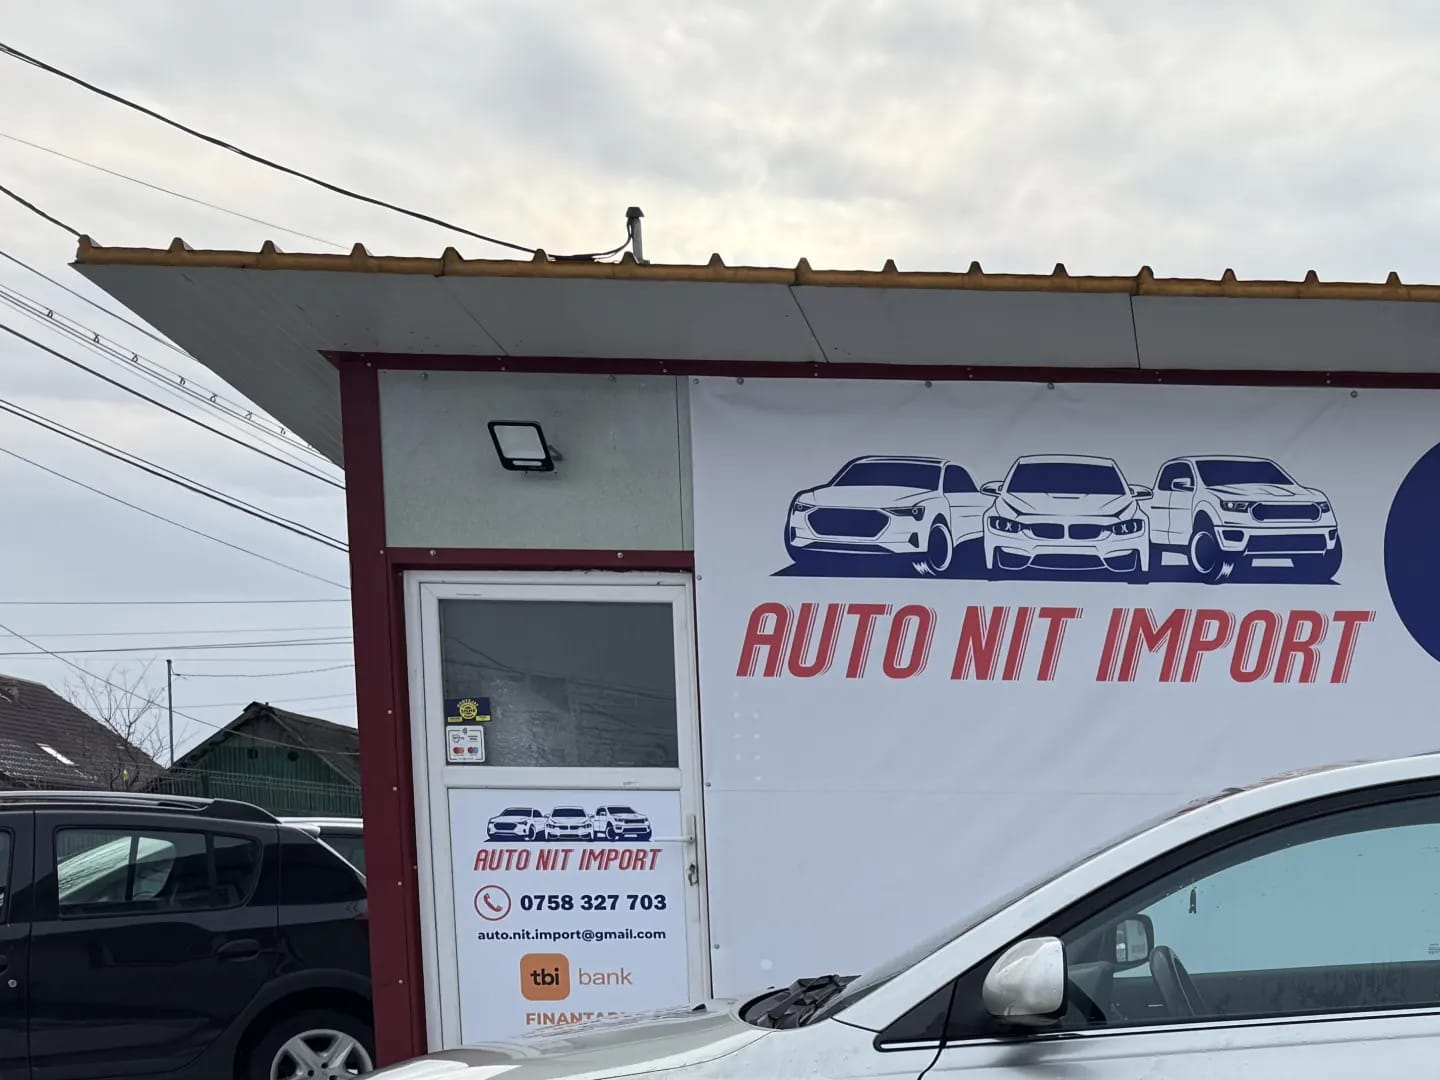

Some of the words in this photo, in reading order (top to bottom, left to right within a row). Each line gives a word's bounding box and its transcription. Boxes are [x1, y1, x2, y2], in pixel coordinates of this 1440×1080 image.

[736, 602, 938, 680] AUTO
[949, 605, 1084, 683] NIT
[1095, 607, 1376, 684] IMPORT
[473, 849, 531, 872] AUTO
[535, 849, 574, 872] NIT
[578, 849, 663, 872] IMPORT
[520, 894, 574, 911] 0758
[580, 894, 620, 911] 327
[626, 894, 667, 911] 703
[477, 928, 667, 942] auto.nit.import@gmail.com
[530, 967, 560, 986] tbi
[578, 967, 633, 986] bank
